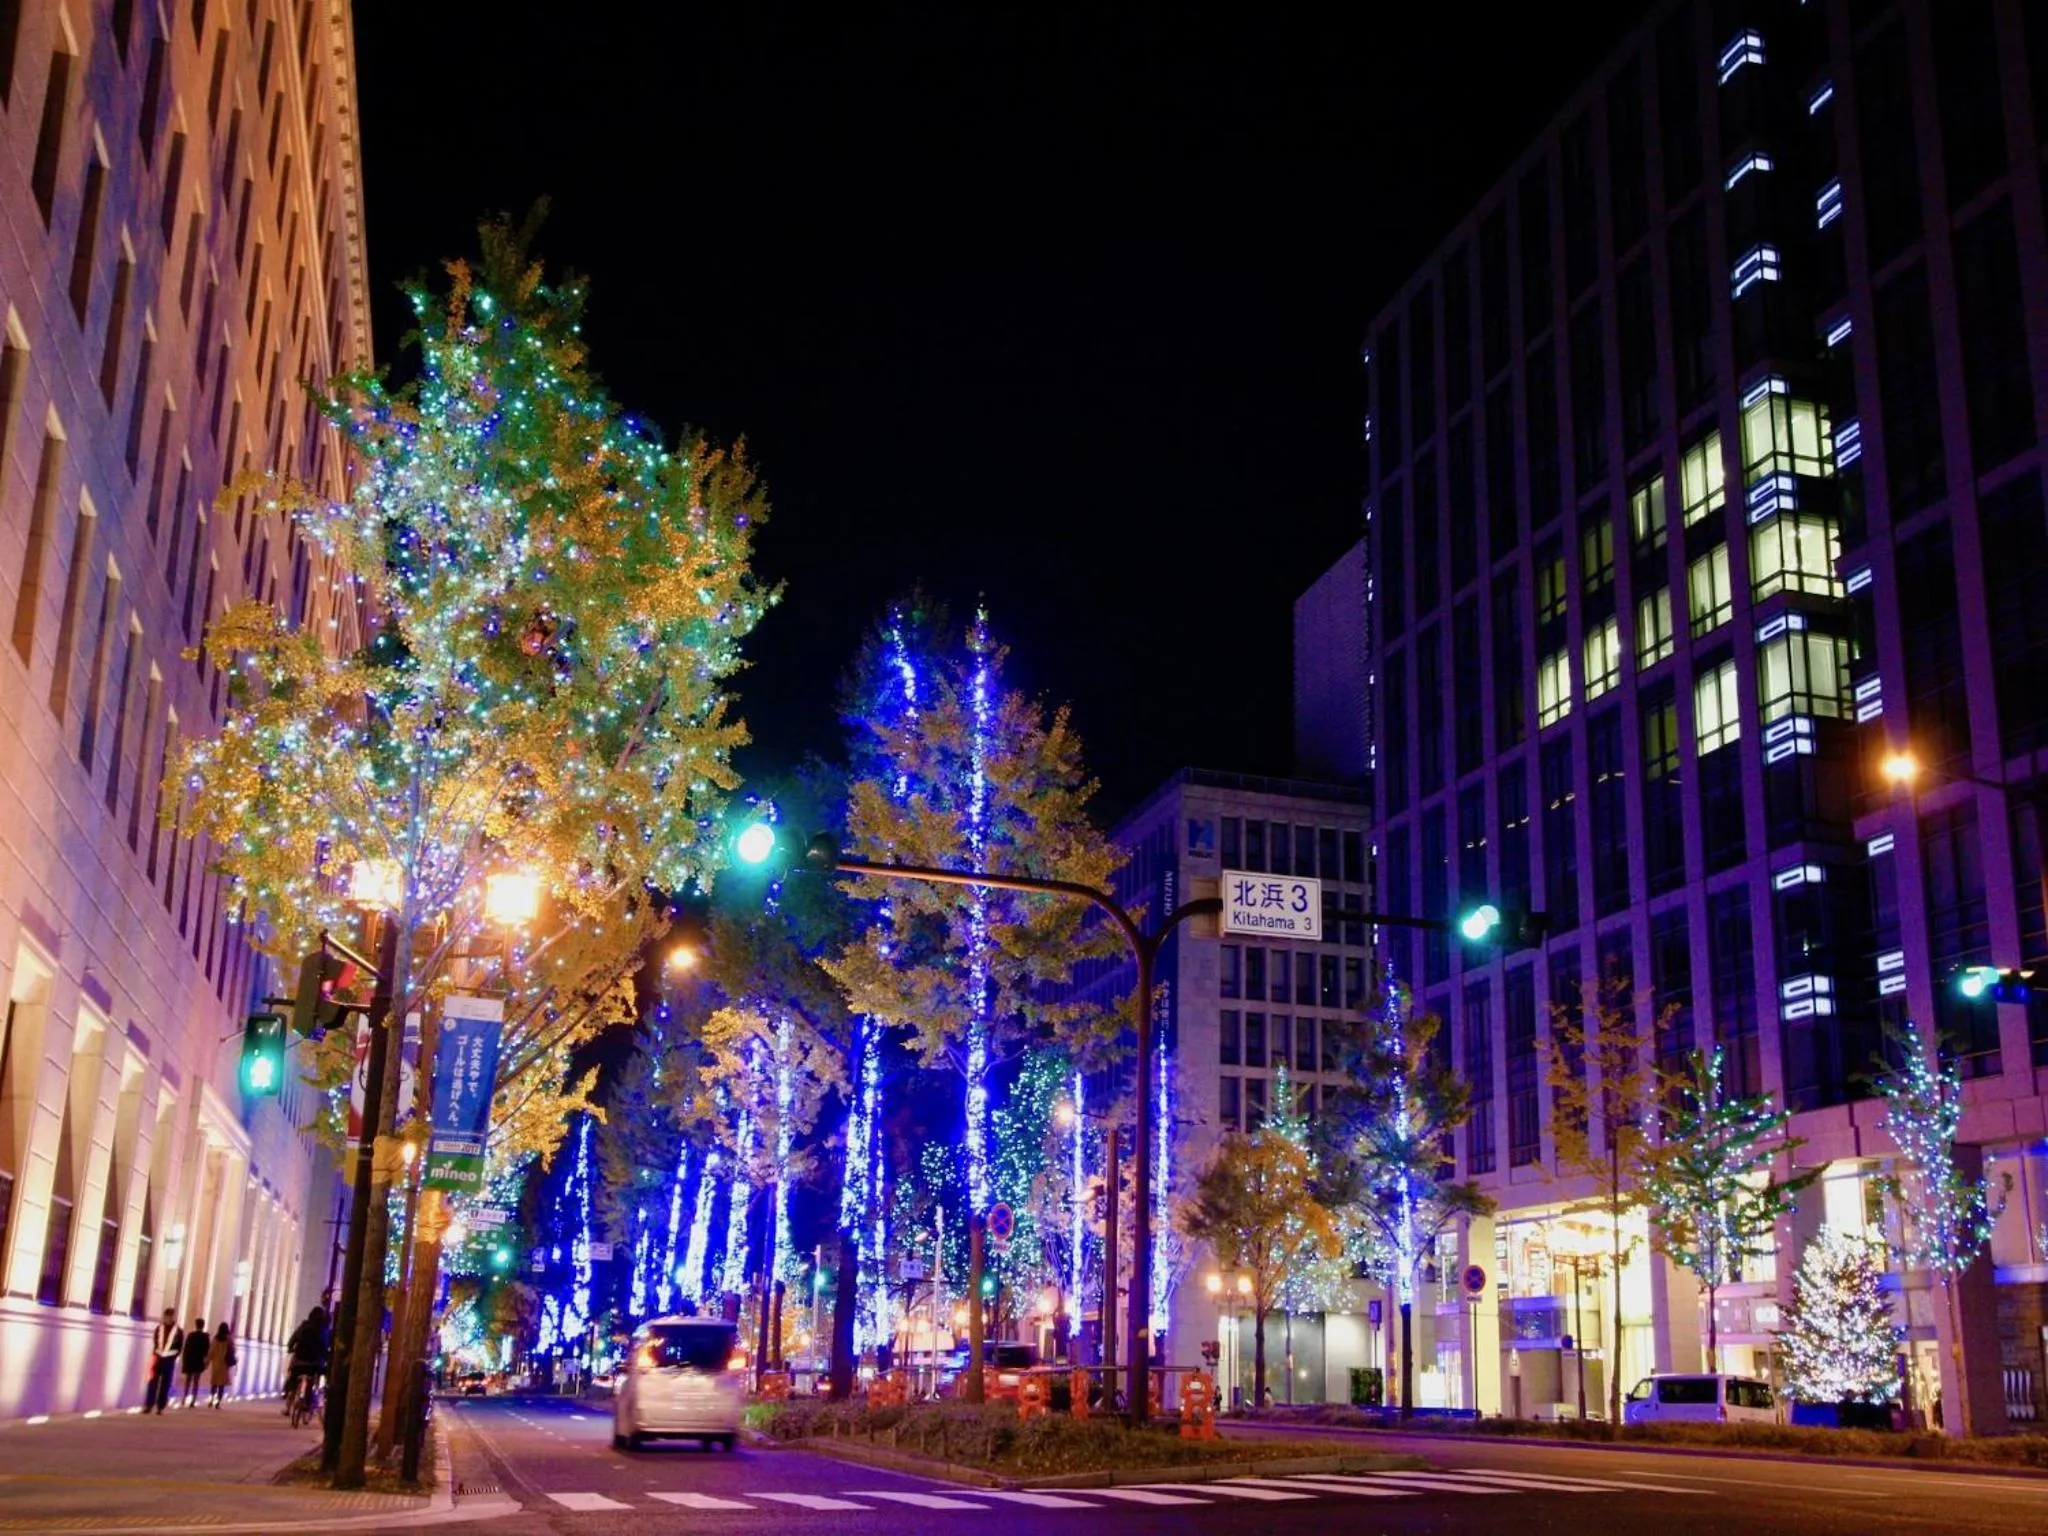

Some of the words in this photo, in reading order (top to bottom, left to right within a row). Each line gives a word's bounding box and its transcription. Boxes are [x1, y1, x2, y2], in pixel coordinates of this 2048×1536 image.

[1163, 870, 1174, 916] MIZUHO
[1233, 880, 1308, 912] 北浜3
[1232, 910, 1296, 930] Kitahama
[1303, 916, 1312, 931] 3
[430, 1160, 478, 1182] mineo
